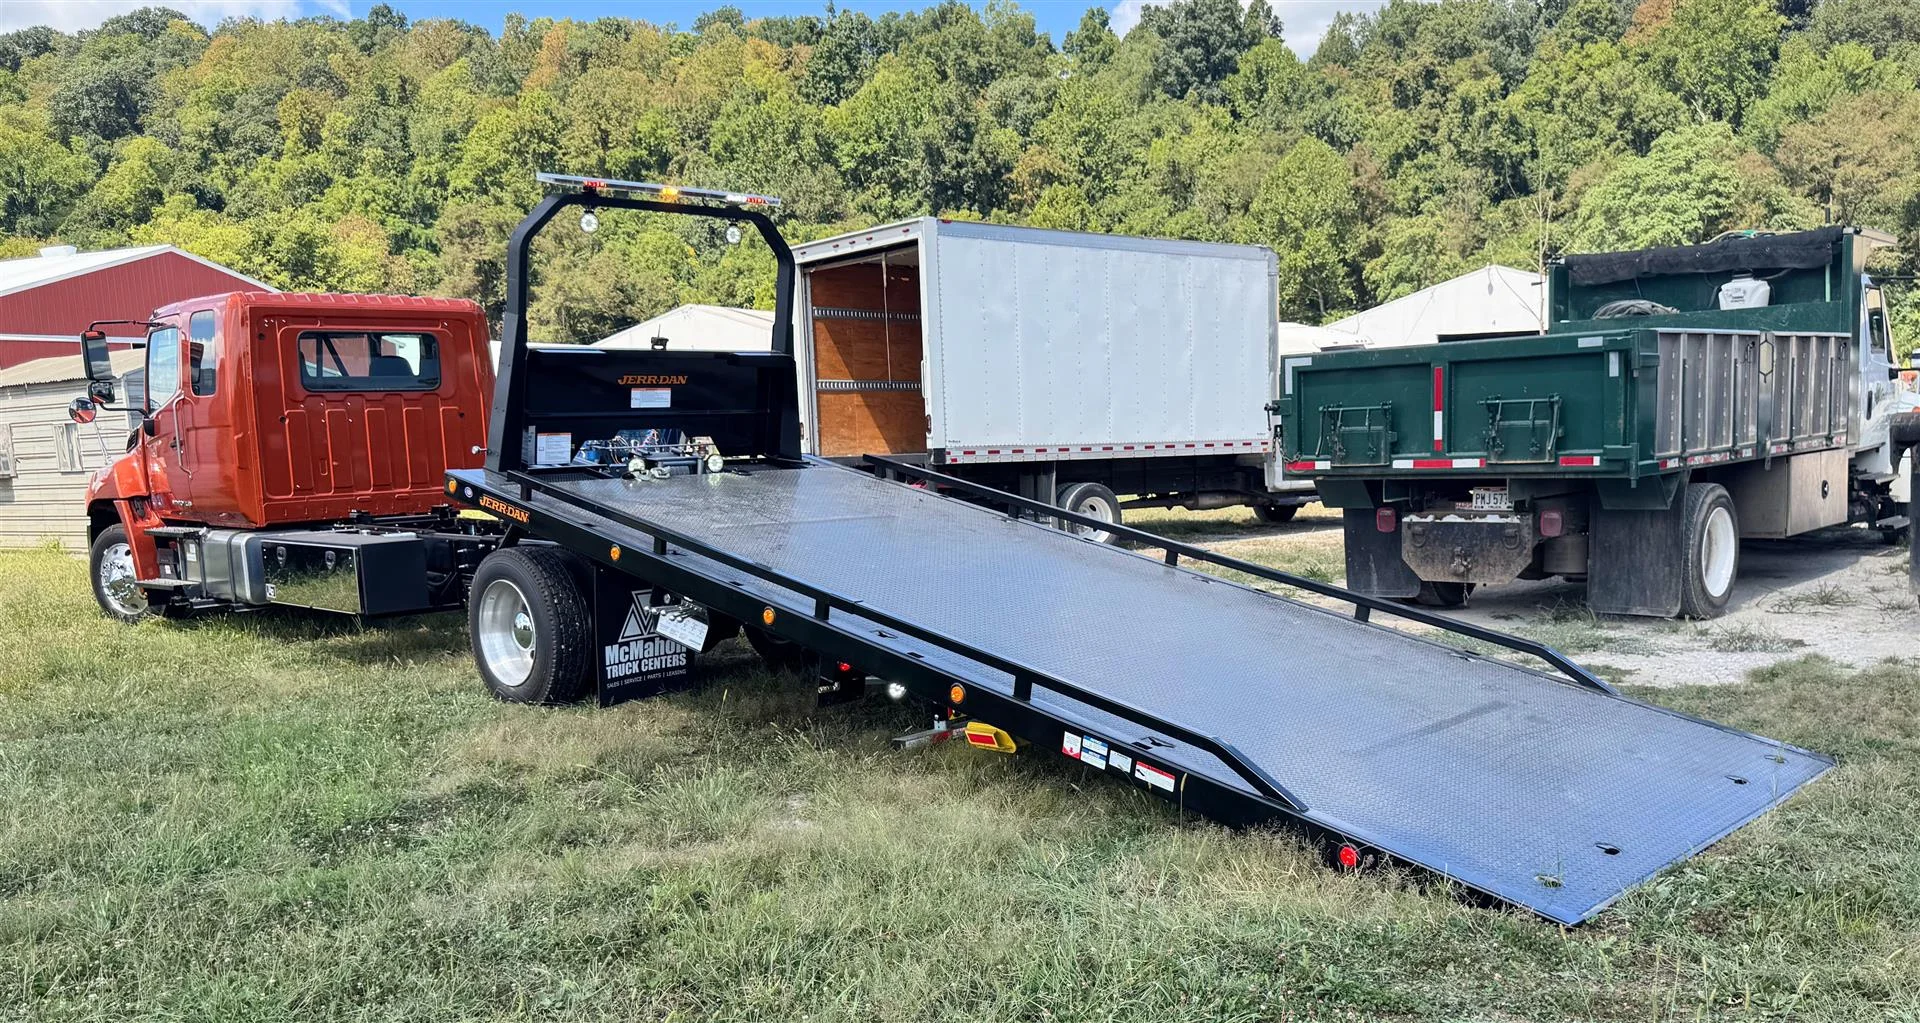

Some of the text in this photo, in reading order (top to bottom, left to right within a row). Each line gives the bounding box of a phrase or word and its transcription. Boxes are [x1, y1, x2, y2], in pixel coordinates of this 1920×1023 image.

[1475, 493, 1491, 505] PMJ
[606, 653, 687, 680] TRUCK CENTERS
[606, 669, 687, 689] SALES SERVICE PARTS LEASING
